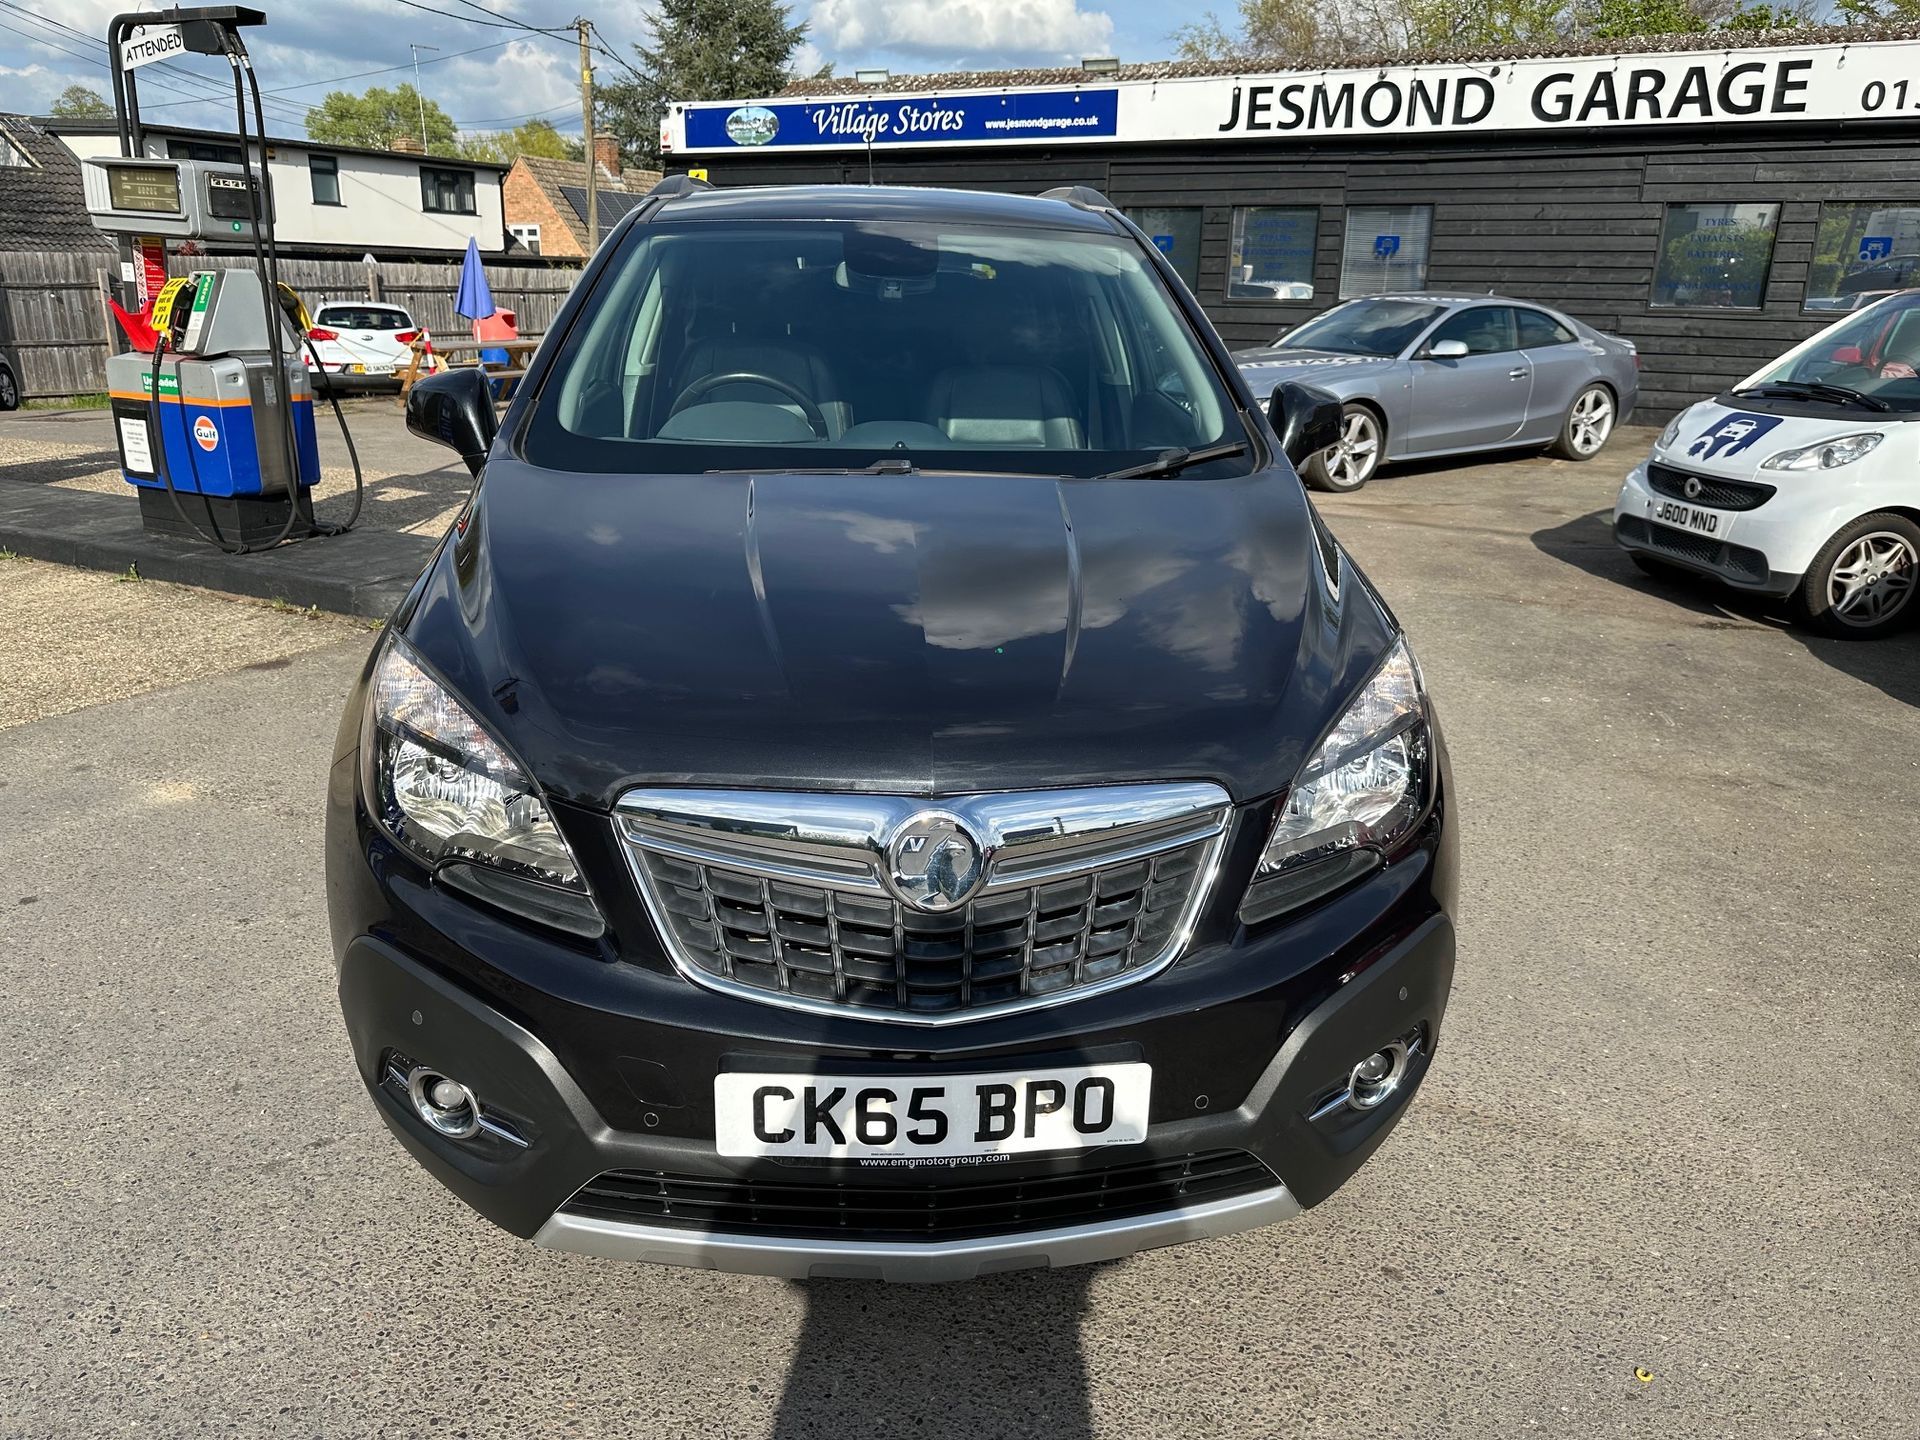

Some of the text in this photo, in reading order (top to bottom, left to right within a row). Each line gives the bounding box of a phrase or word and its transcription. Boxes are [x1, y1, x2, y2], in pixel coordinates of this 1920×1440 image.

[127, 34, 181, 62] ATTENDED
[1219, 60, 1920, 131] JESMOND GARAGE 01
[812, 104, 1099, 143] Village Stores www.jesmondgarage.co.uk
[1705, 218, 1737, 226] TYRES
[1690, 234, 1745, 242] EXHAUSTS
[1687, 250, 1744, 258] BATTERIES
[200, 275, 211, 304] Petrol
[196, 428, 216, 439] Gulf
[1657, 501, 1718, 533] J600 MND
[752, 1076, 1116, 1146] CK65 BPO
[859, 1153, 1010, 1168] www.emgmotorgroup.com
